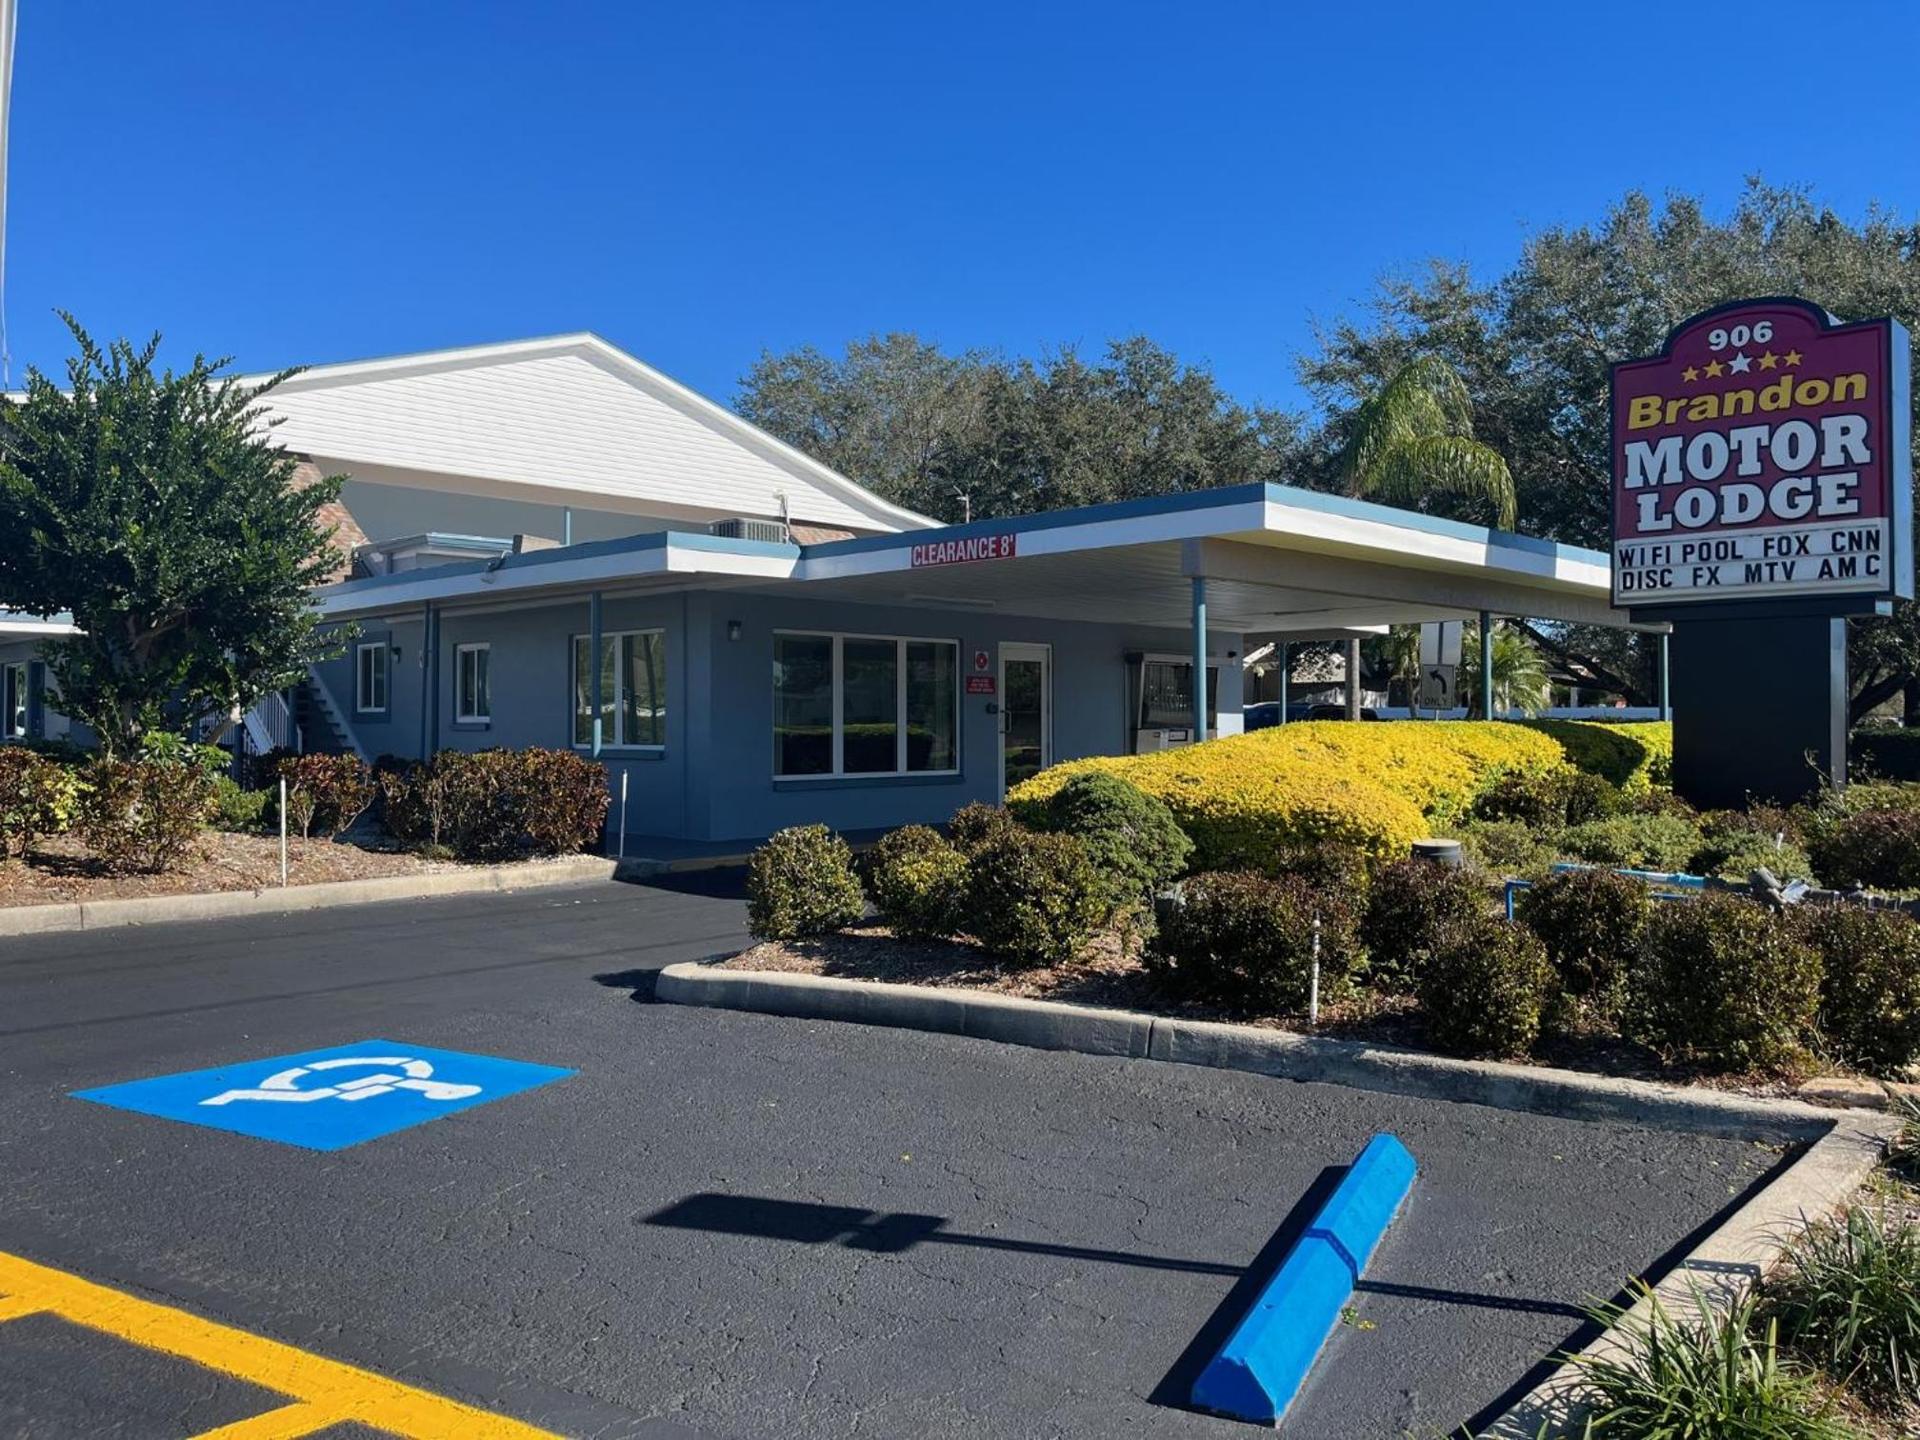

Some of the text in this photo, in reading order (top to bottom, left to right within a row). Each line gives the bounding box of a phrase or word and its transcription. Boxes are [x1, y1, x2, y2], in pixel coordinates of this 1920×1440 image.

[1708, 321, 1774, 351] 906
[1627, 371, 1868, 430] Brandon
[1624, 414, 1871, 489] MOTOR
[1636, 472, 1858, 532] LODGE
[912, 535, 1014, 566] CLEARANCE 8'
[1618, 529, 1881, 568] WIFI POOL FOX CNN
[1622, 554, 1881, 591] DISC FX MTV AMC
[1424, 696, 1448, 706] ONLY
